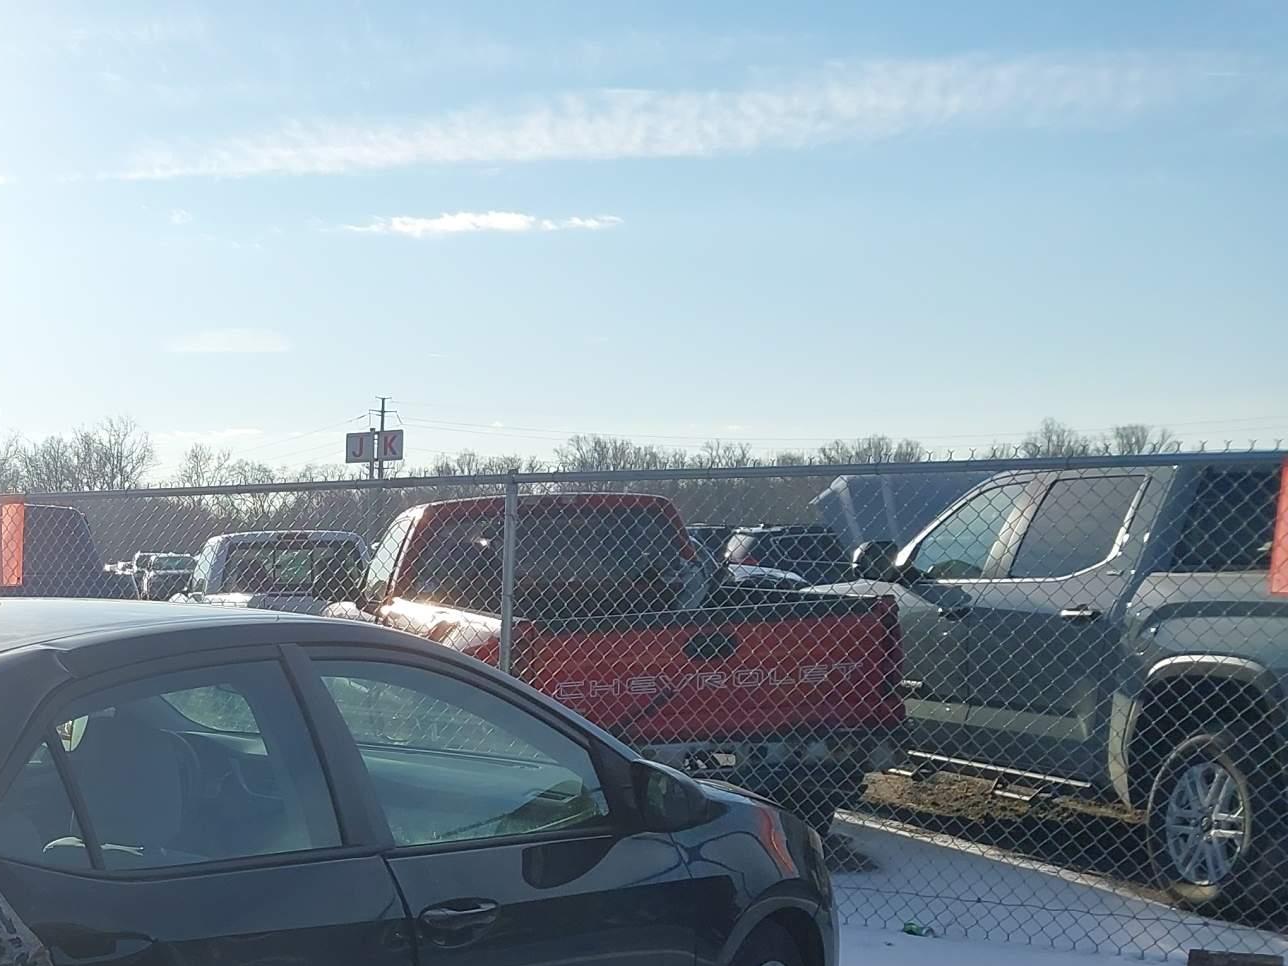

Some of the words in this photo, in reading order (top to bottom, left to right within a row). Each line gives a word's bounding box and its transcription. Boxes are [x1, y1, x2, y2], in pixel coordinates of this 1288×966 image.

[352, 436, 364, 458] J
[383, 435, 398, 456] K
[554, 662, 863, 700] CHEVROLET
